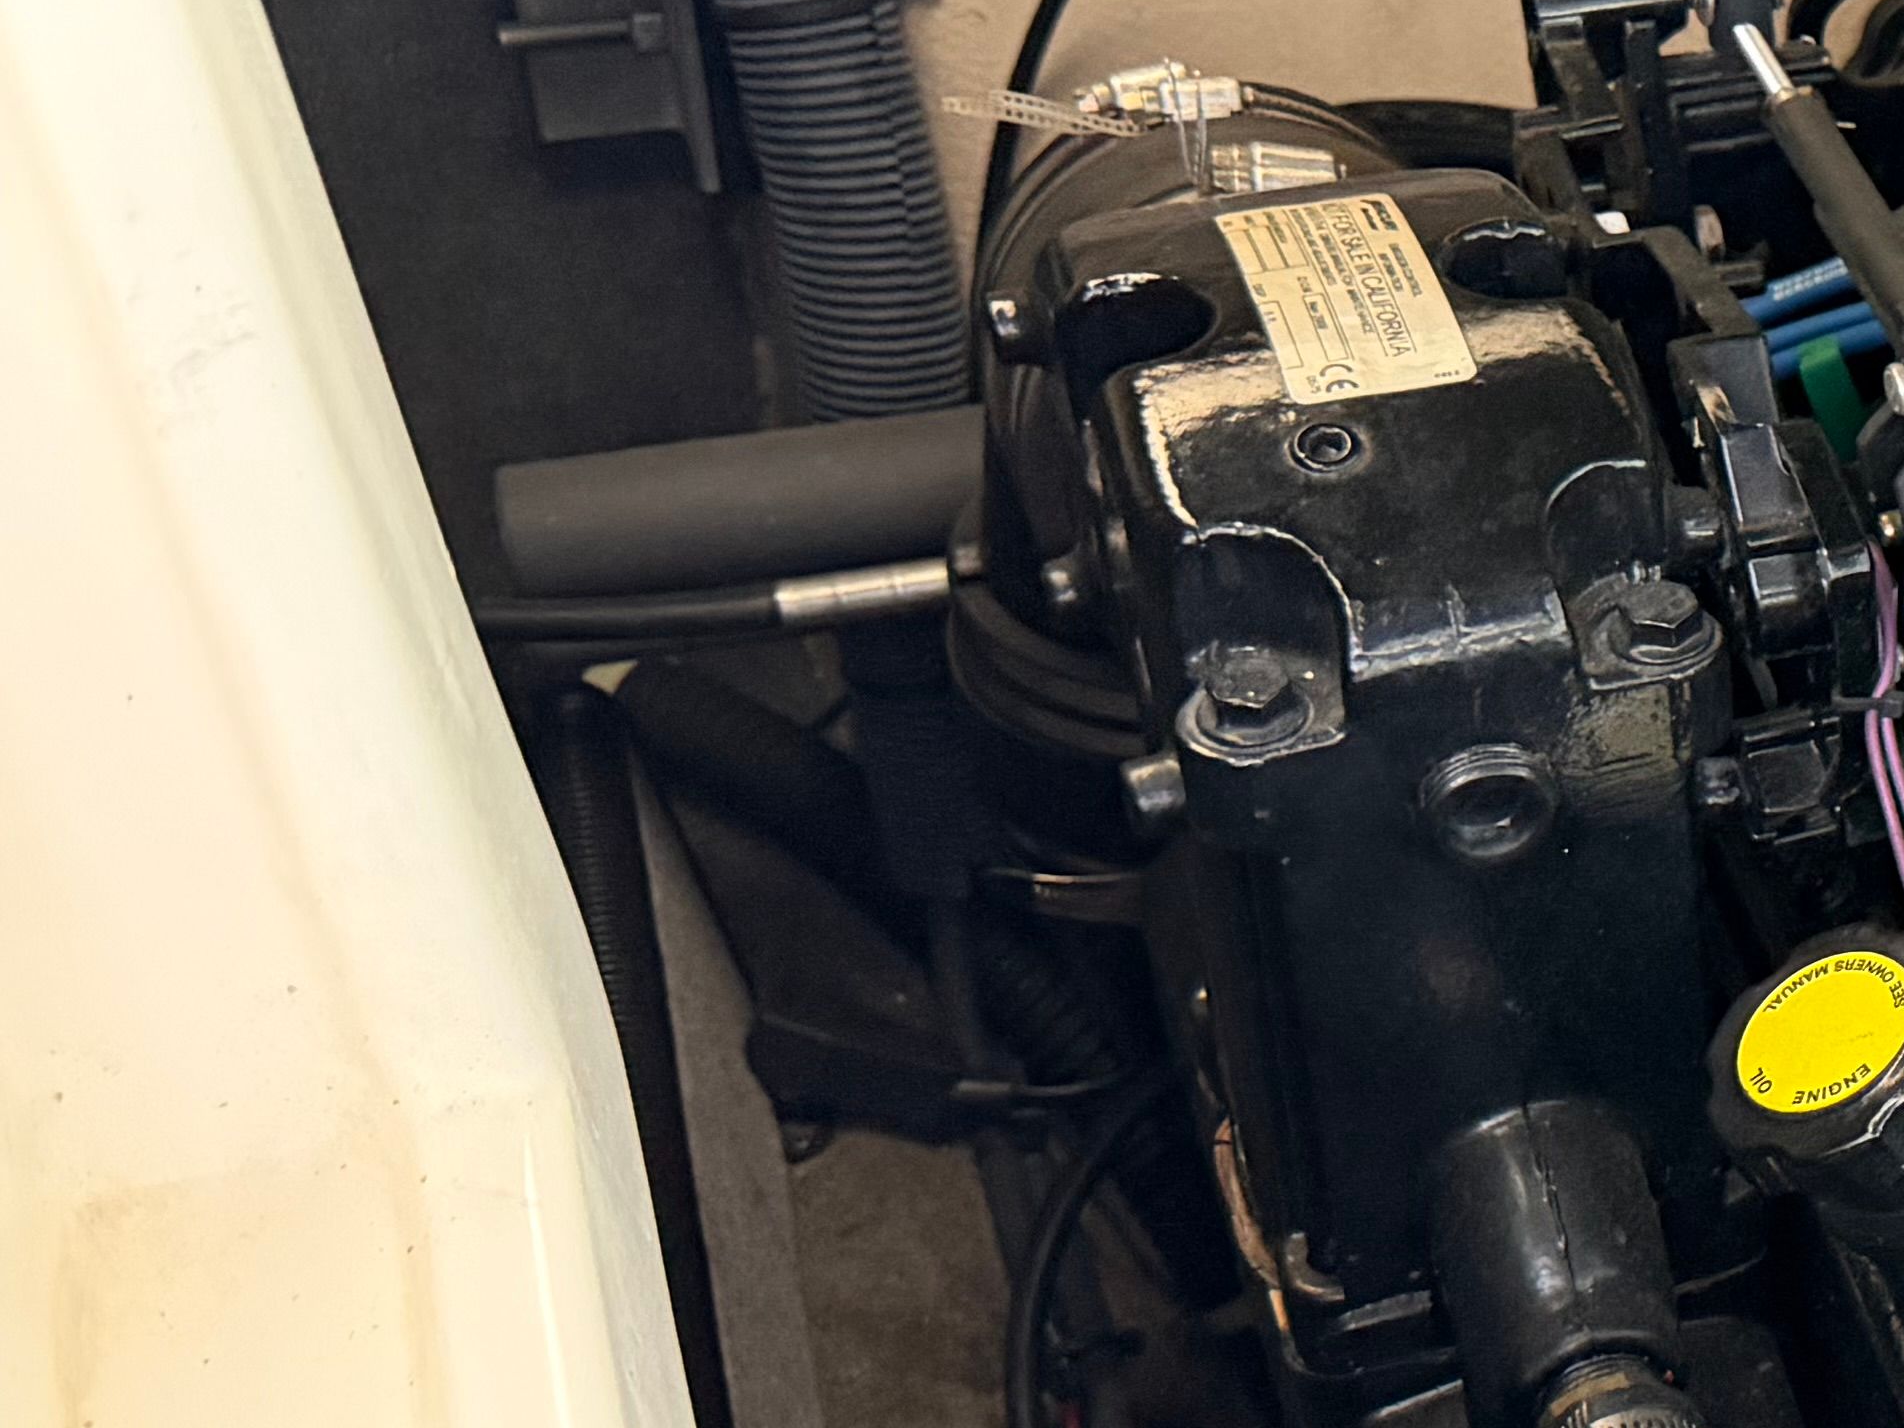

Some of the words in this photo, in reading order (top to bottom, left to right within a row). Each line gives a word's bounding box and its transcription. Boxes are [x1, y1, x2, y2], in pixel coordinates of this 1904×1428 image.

[1329, 213, 1356, 239] FOR
[1341, 235, 1369, 263] SALE
[1353, 262, 1377, 277] IN
[1360, 273, 1411, 356] CALIFORNIA
[1833, 957, 1895, 984] OWNERS
[1761, 962, 1829, 1013] MANUAL
[1749, 1066, 1773, 1095] OIL
[1791, 1062, 1873, 1104] ENGINE
